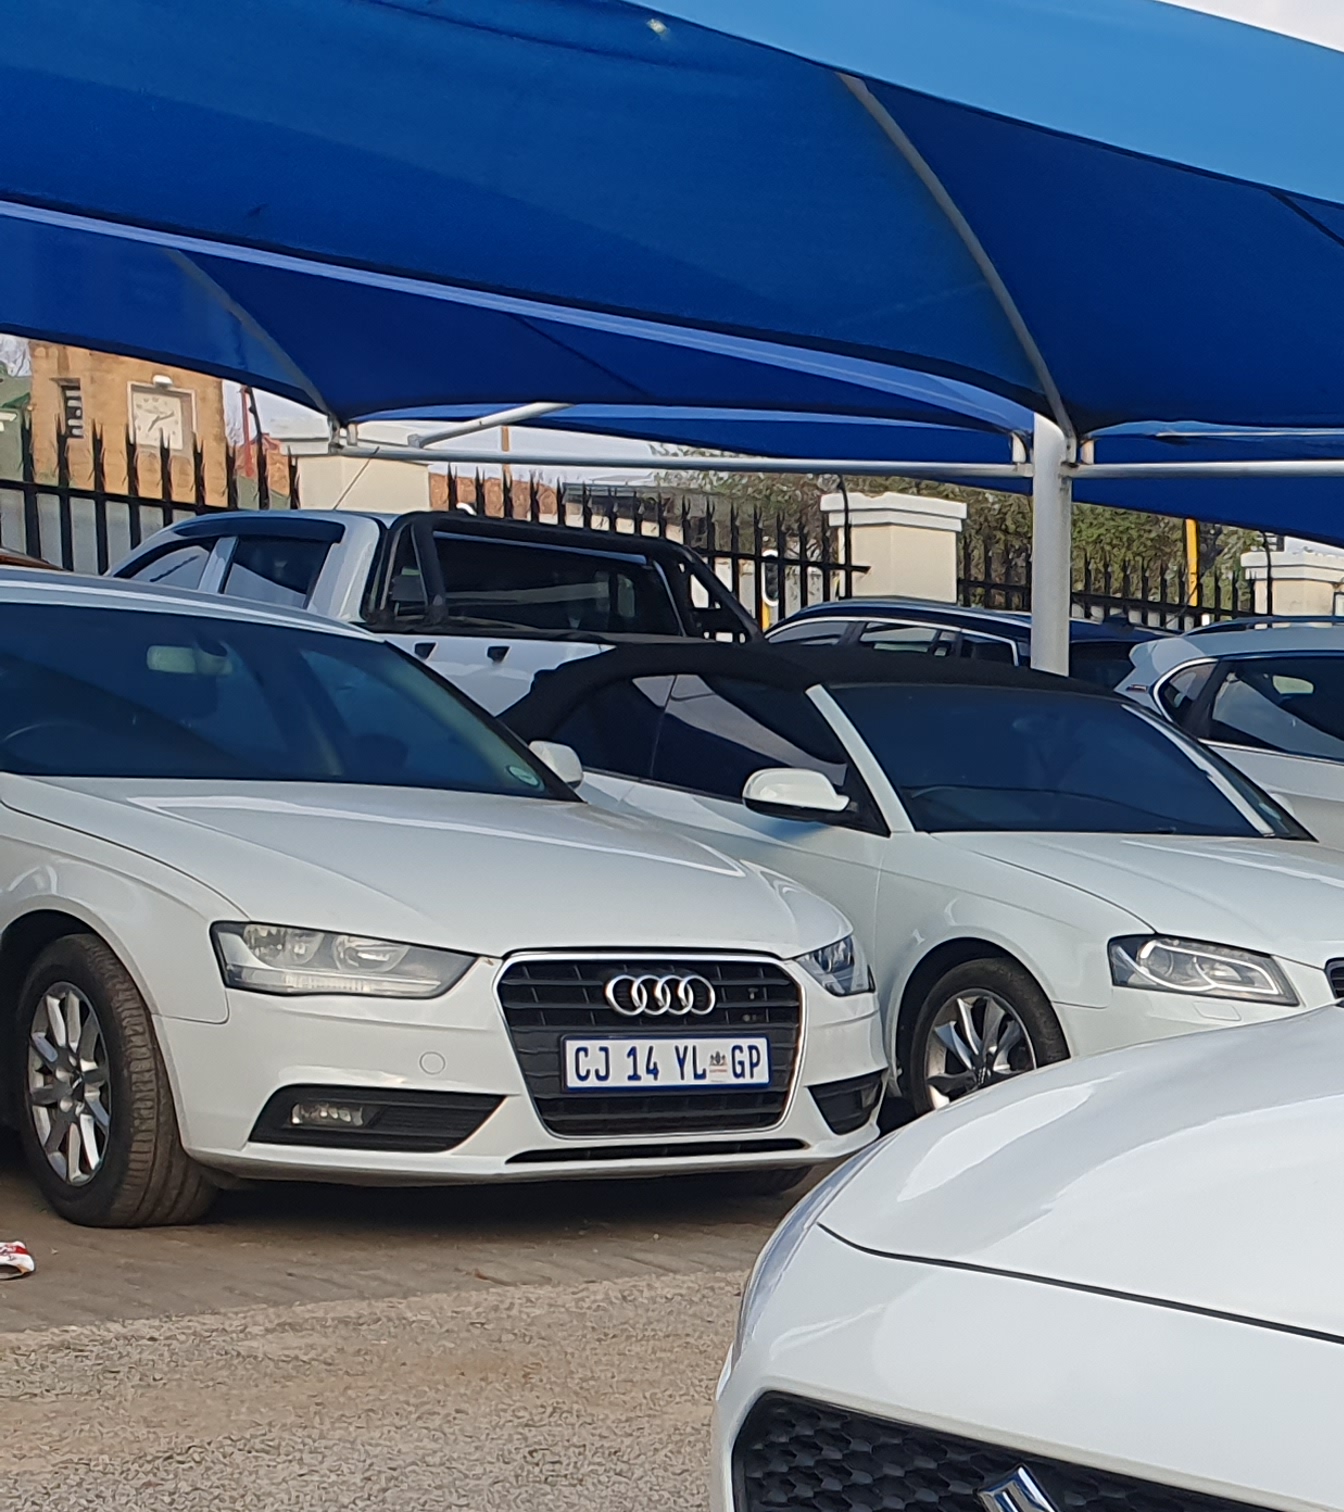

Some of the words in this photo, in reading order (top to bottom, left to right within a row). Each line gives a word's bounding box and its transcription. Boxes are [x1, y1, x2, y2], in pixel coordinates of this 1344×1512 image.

[574, 1046, 611, 1082] CJ
[626, 1045, 660, 1082] 14
[675, 1044, 707, 1081] YL
[731, 1043, 761, 1079] GP
